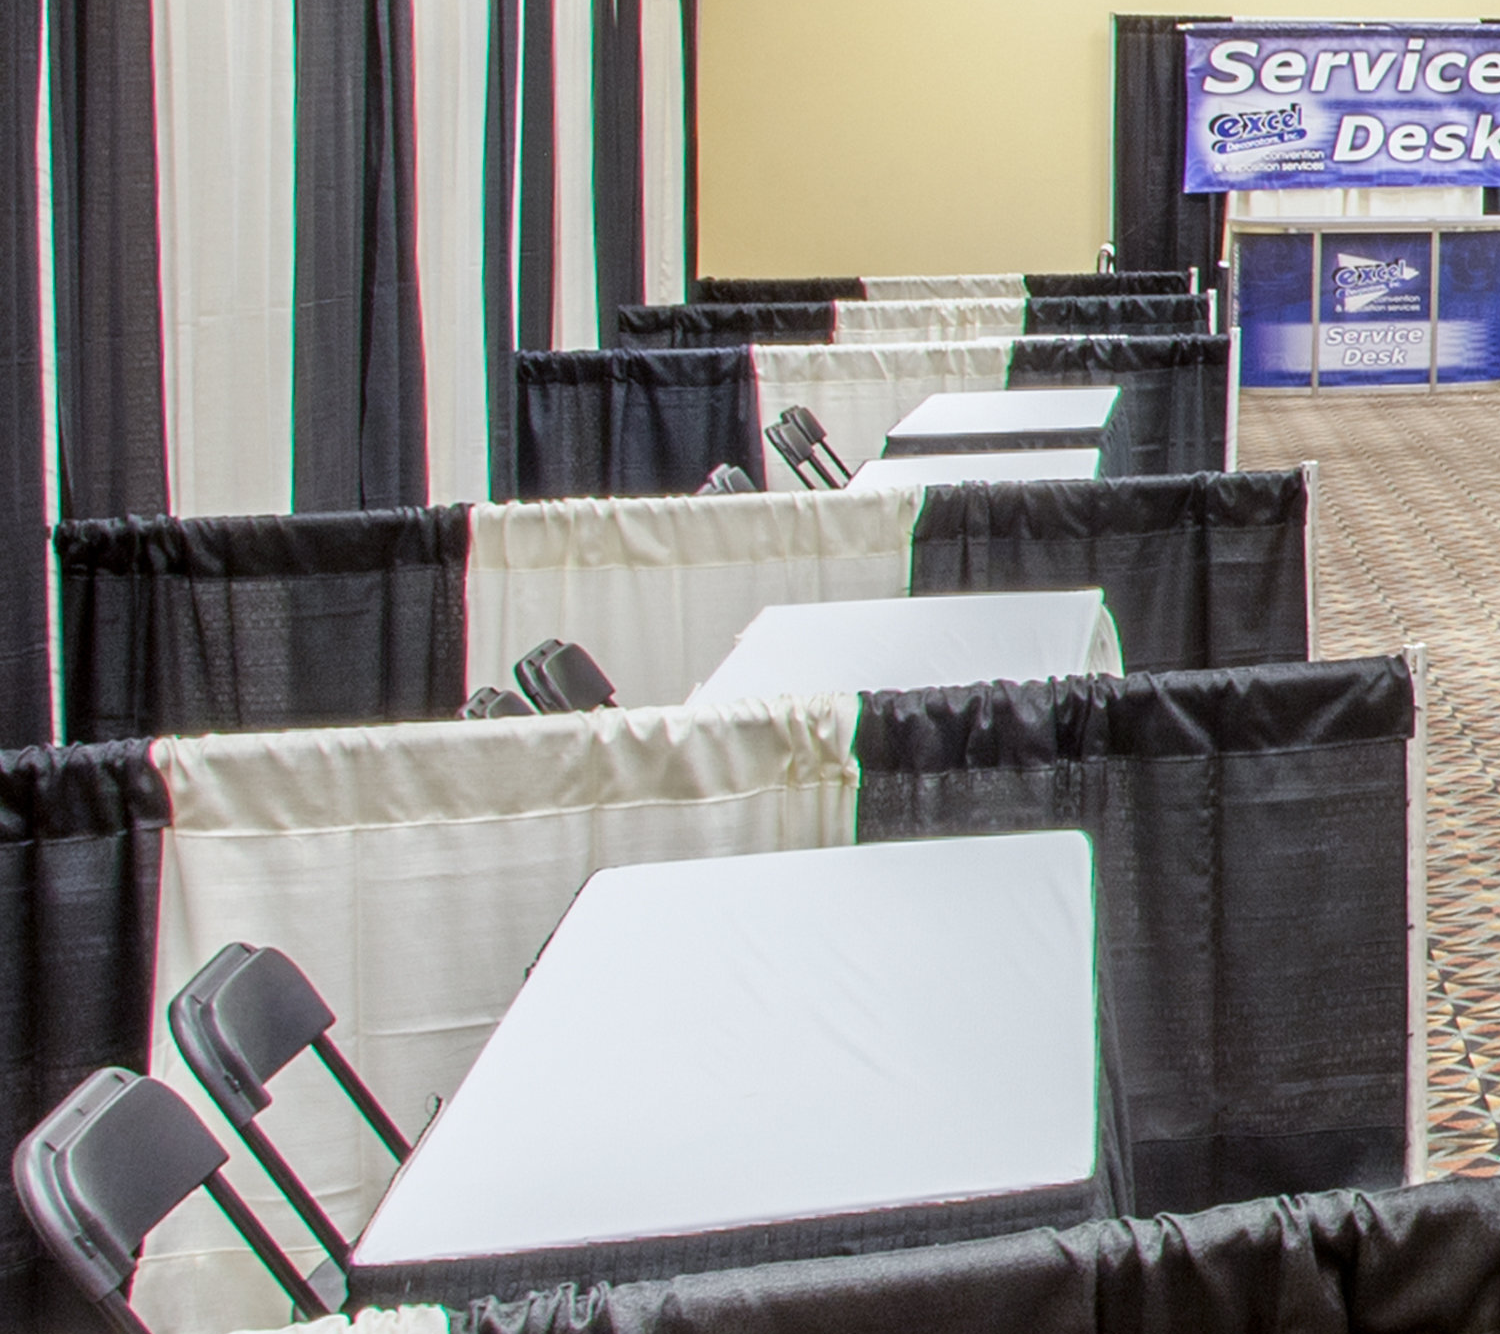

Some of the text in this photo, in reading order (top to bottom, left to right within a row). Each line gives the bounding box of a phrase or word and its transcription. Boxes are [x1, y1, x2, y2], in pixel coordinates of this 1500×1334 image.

[1208, 102, 1302, 140] excel
[1262, 149, 1326, 162] convention
[1281, 161, 1326, 172] services
[1332, 258, 1406, 288] excel
[1326, 326, 1424, 346] Service
[1343, 347, 1407, 366] Desk
